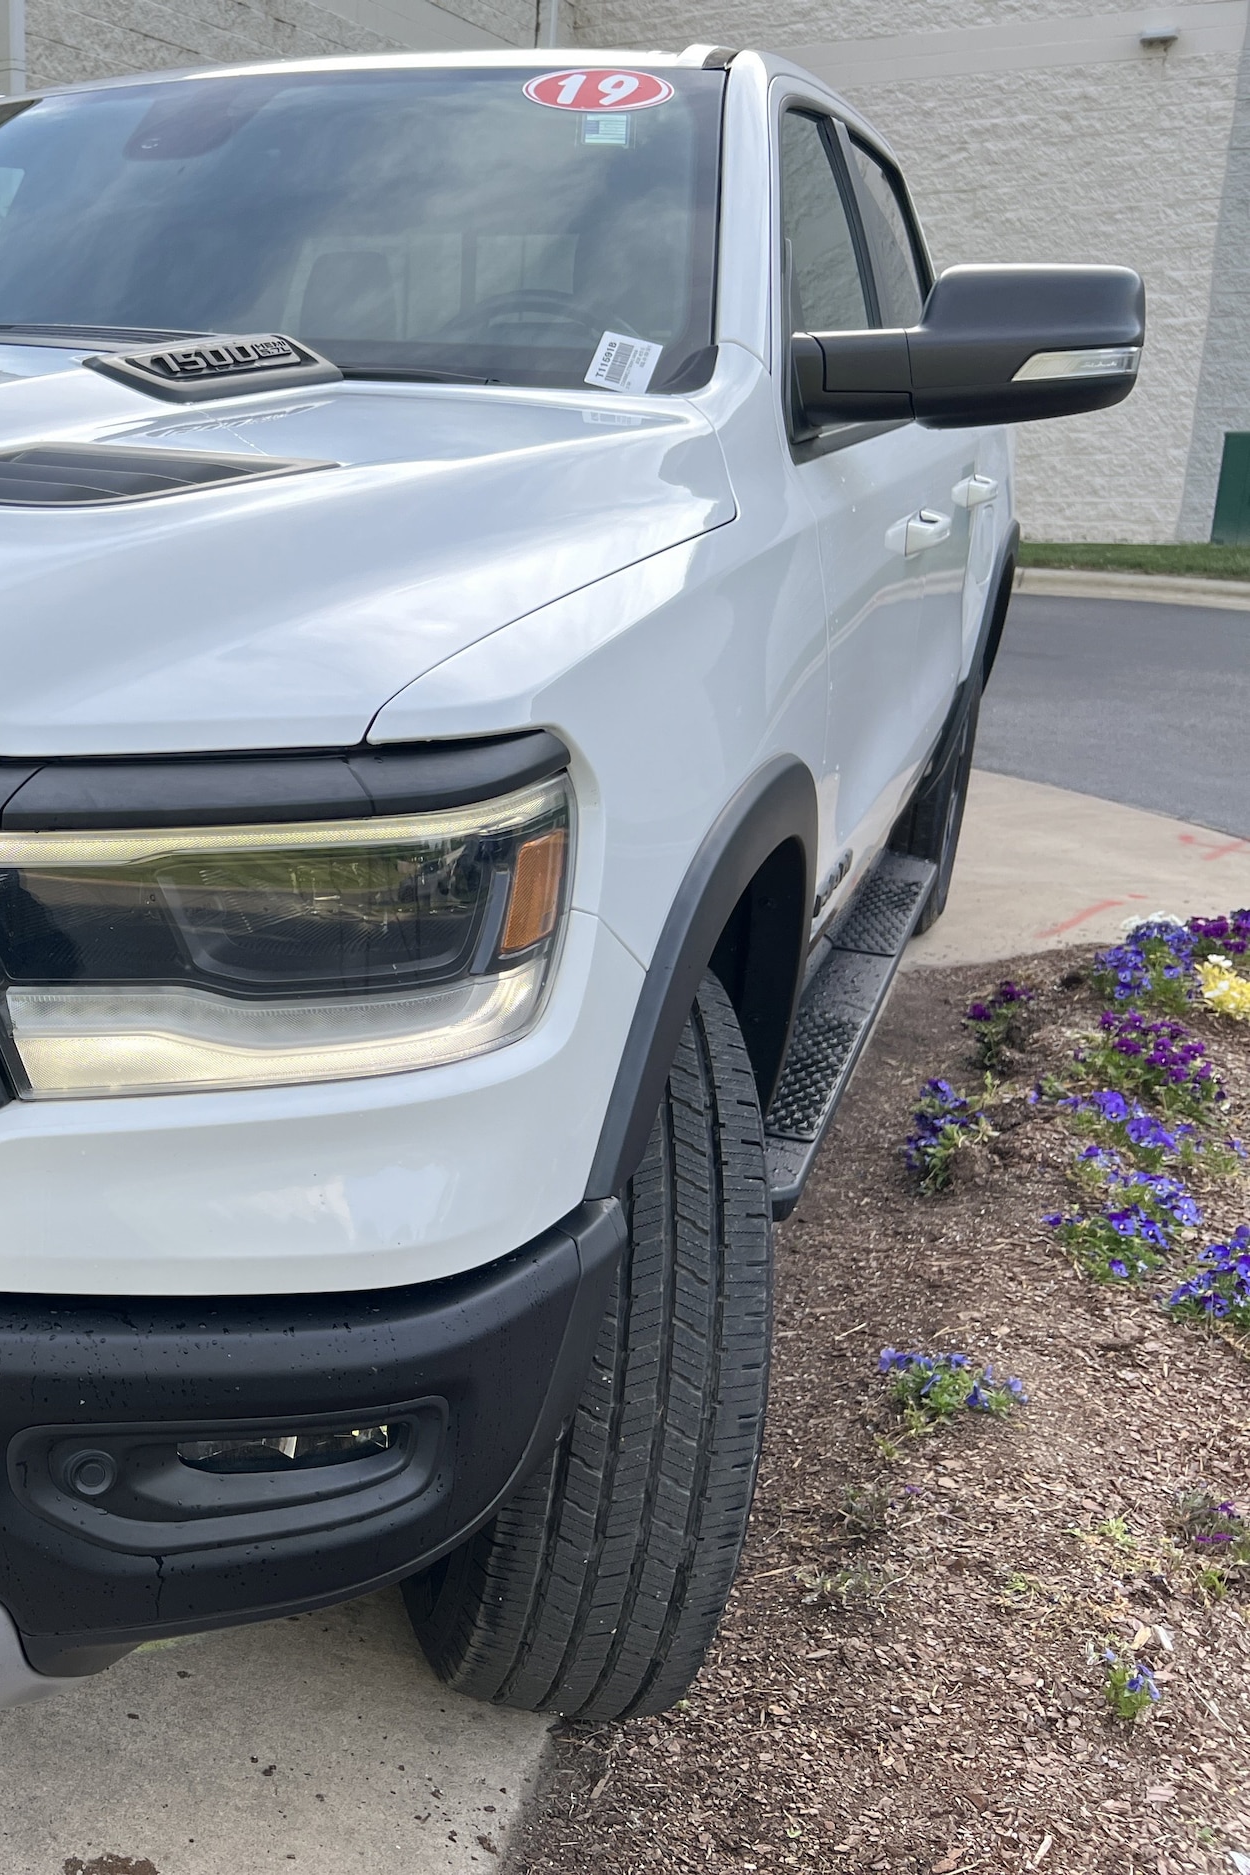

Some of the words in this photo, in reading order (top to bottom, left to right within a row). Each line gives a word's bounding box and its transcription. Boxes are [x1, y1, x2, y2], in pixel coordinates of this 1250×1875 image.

[556, 74, 639, 106] 19
[151, 345, 259, 373] 1500
[254, 341, 286, 350] HEMI
